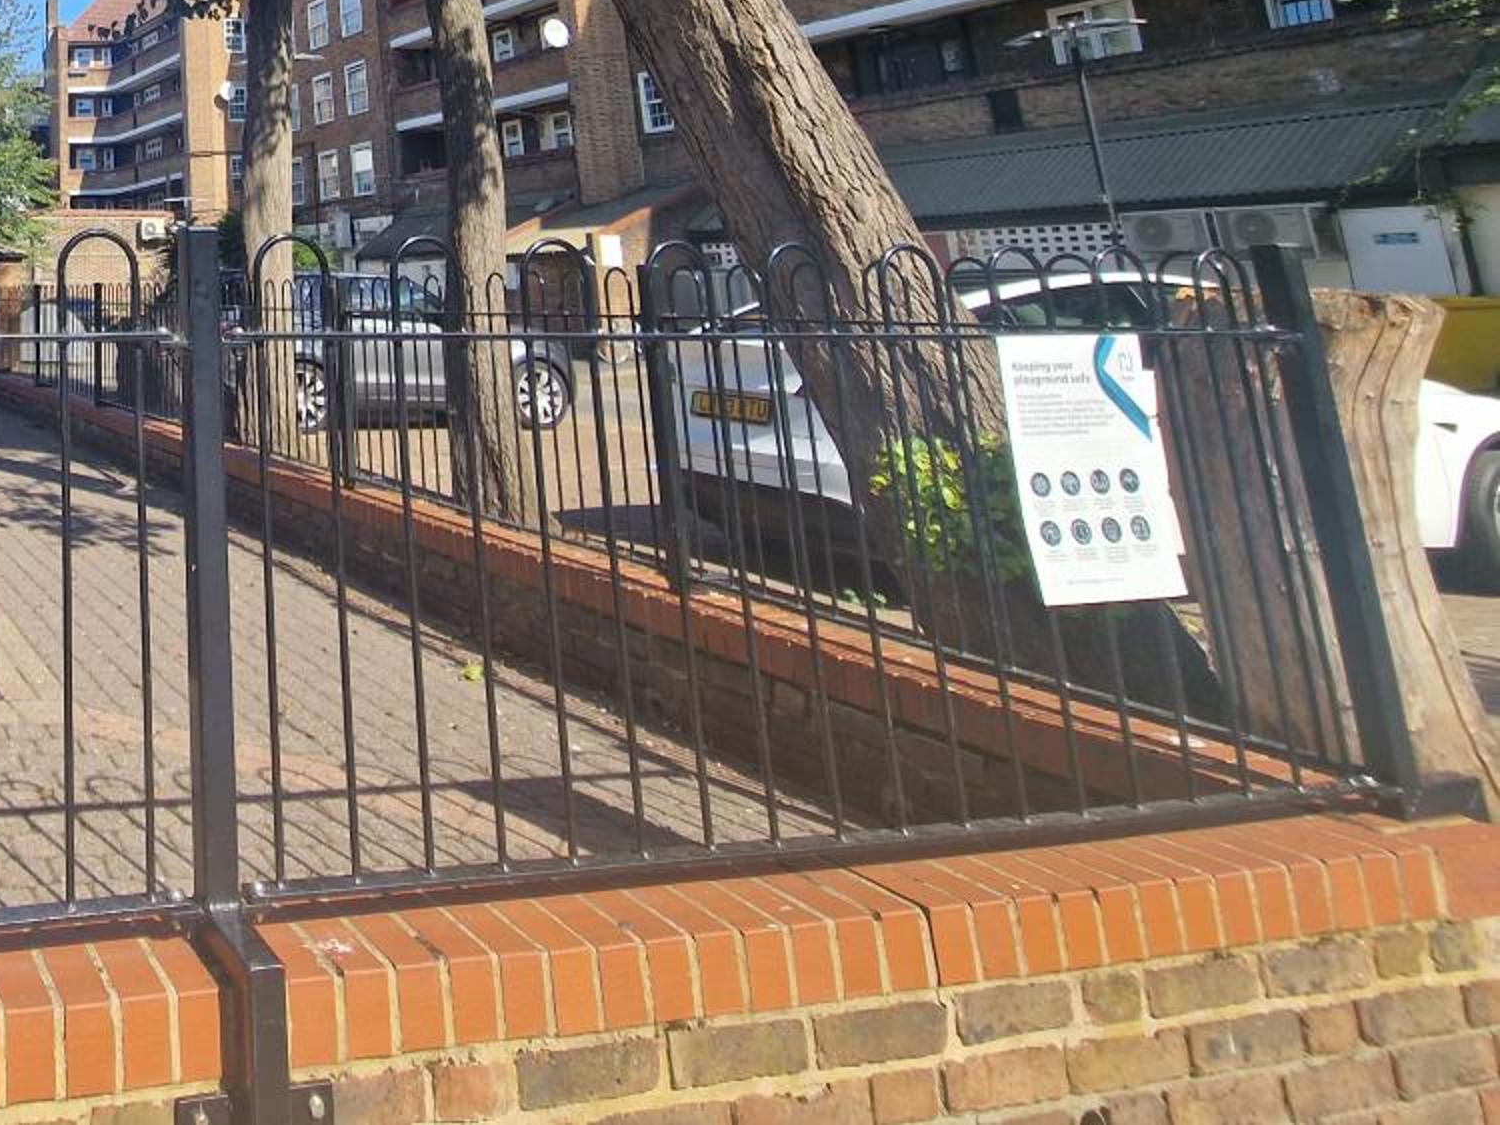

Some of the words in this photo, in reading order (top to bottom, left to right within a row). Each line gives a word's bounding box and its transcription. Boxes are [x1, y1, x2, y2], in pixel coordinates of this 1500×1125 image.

[1011, 362, 1050, 373] Keeping
[1052, 362, 1073, 372] your
[1014, 374, 1069, 386] playground
